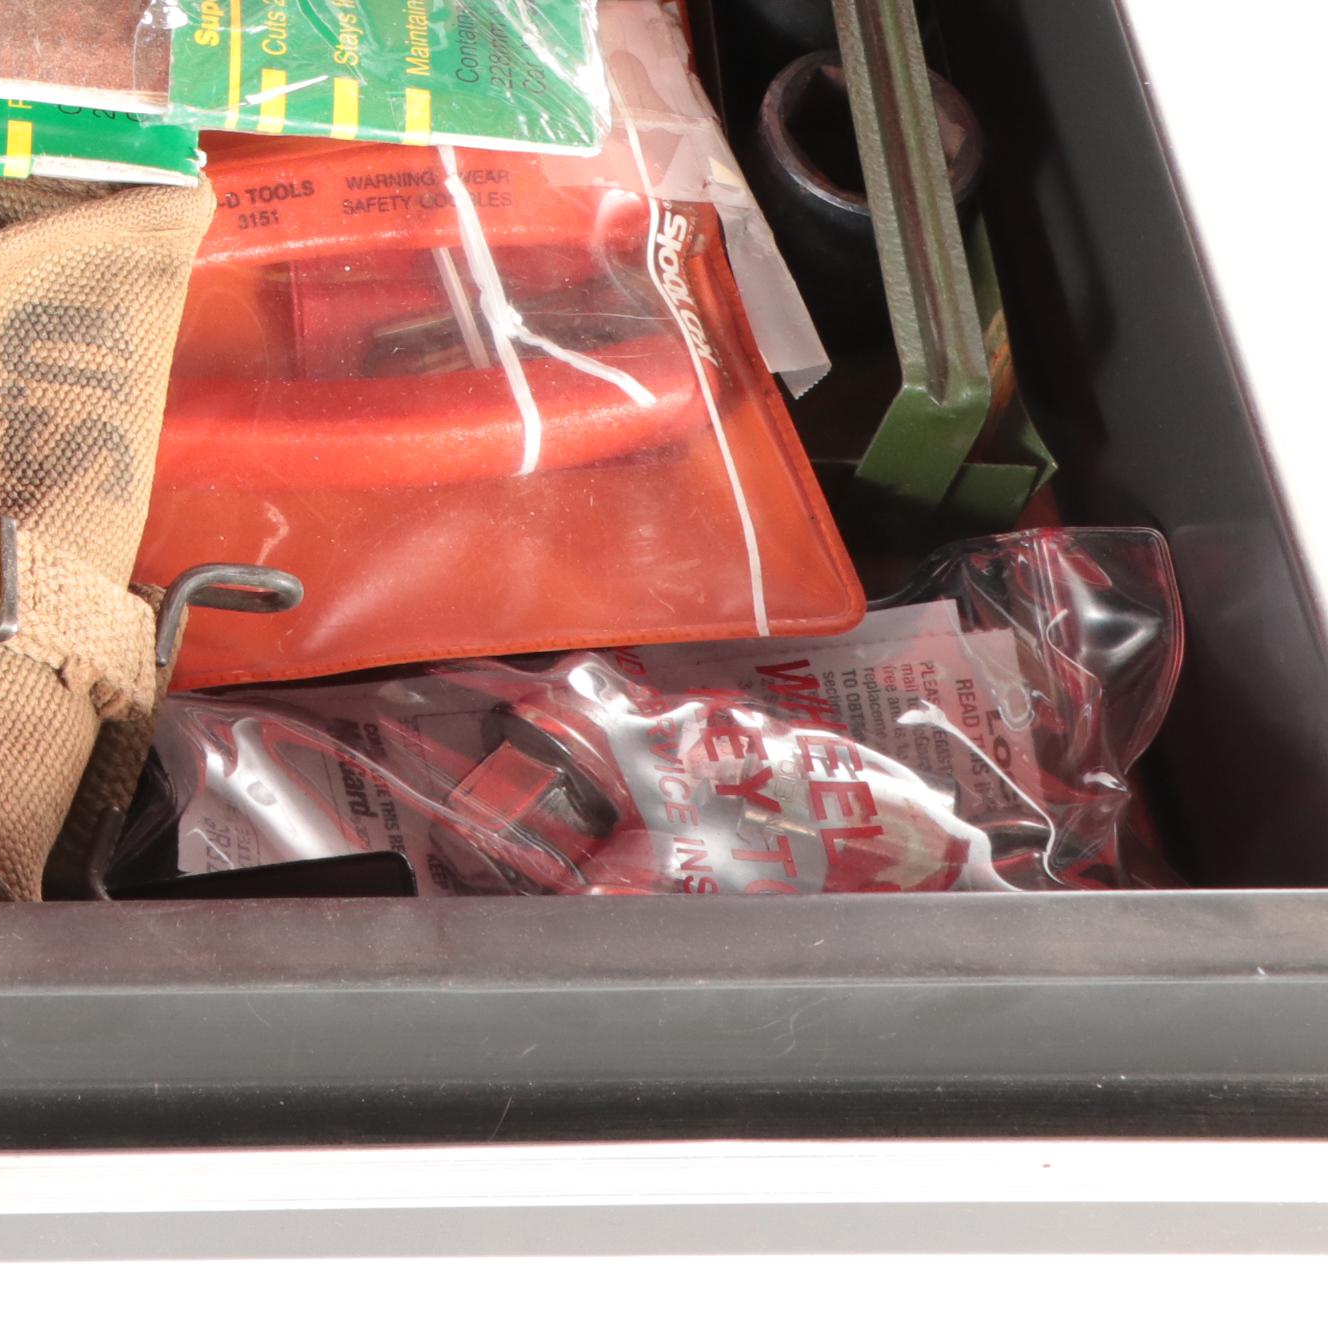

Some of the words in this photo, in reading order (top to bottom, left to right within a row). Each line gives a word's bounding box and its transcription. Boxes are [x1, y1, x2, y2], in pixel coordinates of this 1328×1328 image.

[261, 10, 289, 56] Cuts
[333, 12, 364, 65] Stays
[246, 180, 315, 205] TOOLS
[345, 170, 435, 191] WARNING
[341, 193, 412, 217] SAFETY
[237, 209, 280, 231] 3151
[840, 668, 858, 692] TO
[954, 678, 979, 729] READ
